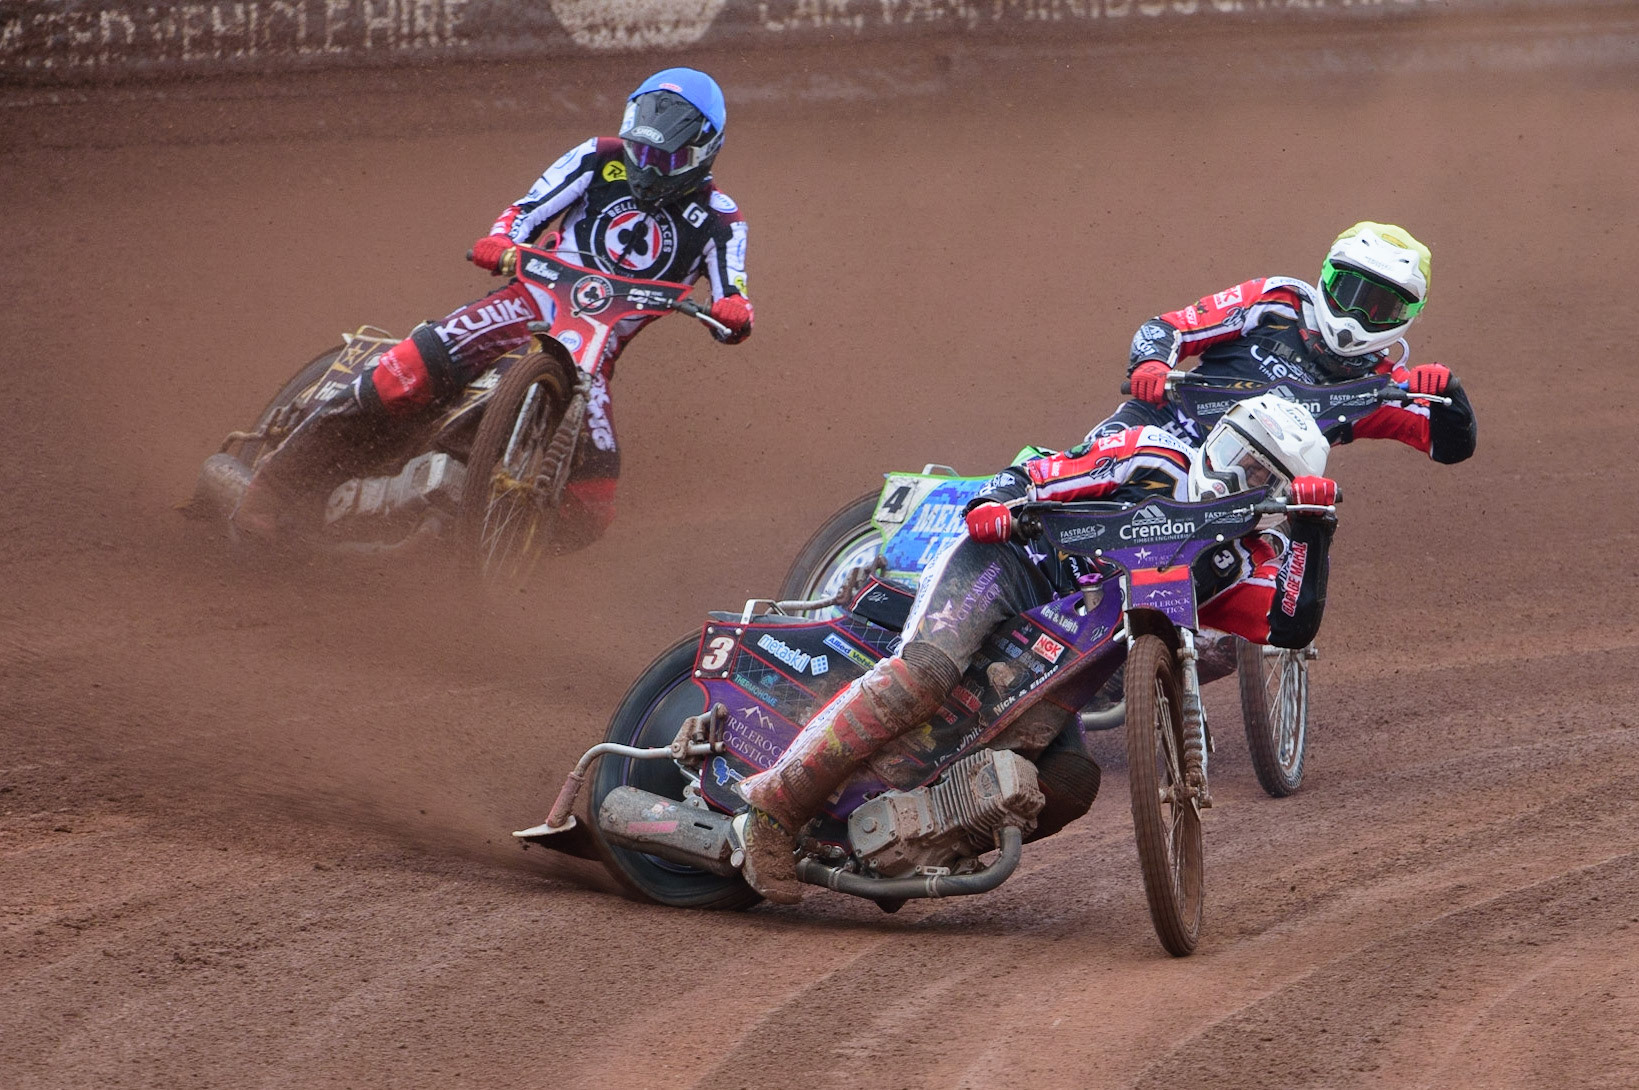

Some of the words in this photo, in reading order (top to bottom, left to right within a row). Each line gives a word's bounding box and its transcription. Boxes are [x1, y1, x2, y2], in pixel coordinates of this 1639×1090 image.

[660, 224, 673, 253] ACES
[1196, 400, 1230, 411] FASTRACK
[881, 486, 912, 513] 4
[1060, 525, 1096, 539] FASTRACK
[1119, 519, 1195, 540] Crendon
[1290, 541, 1307, 577] MAHAL
[957, 594, 976, 621] CITY
[972, 561, 1002, 595] AUCTION
[1282, 576, 1300, 617] GARAGE
[701, 636, 735, 670] 3
[757, 634, 811, 673] metaskil
[827, 636, 850, 654] Allied
[1036, 637, 1062, 657] NGK
[734, 674, 778, 707] THERMOHOME
[993, 696, 1017, 716] Nick
[1030, 664, 1059, 690] Elaine
[723, 731, 774, 769] OGISTICS
